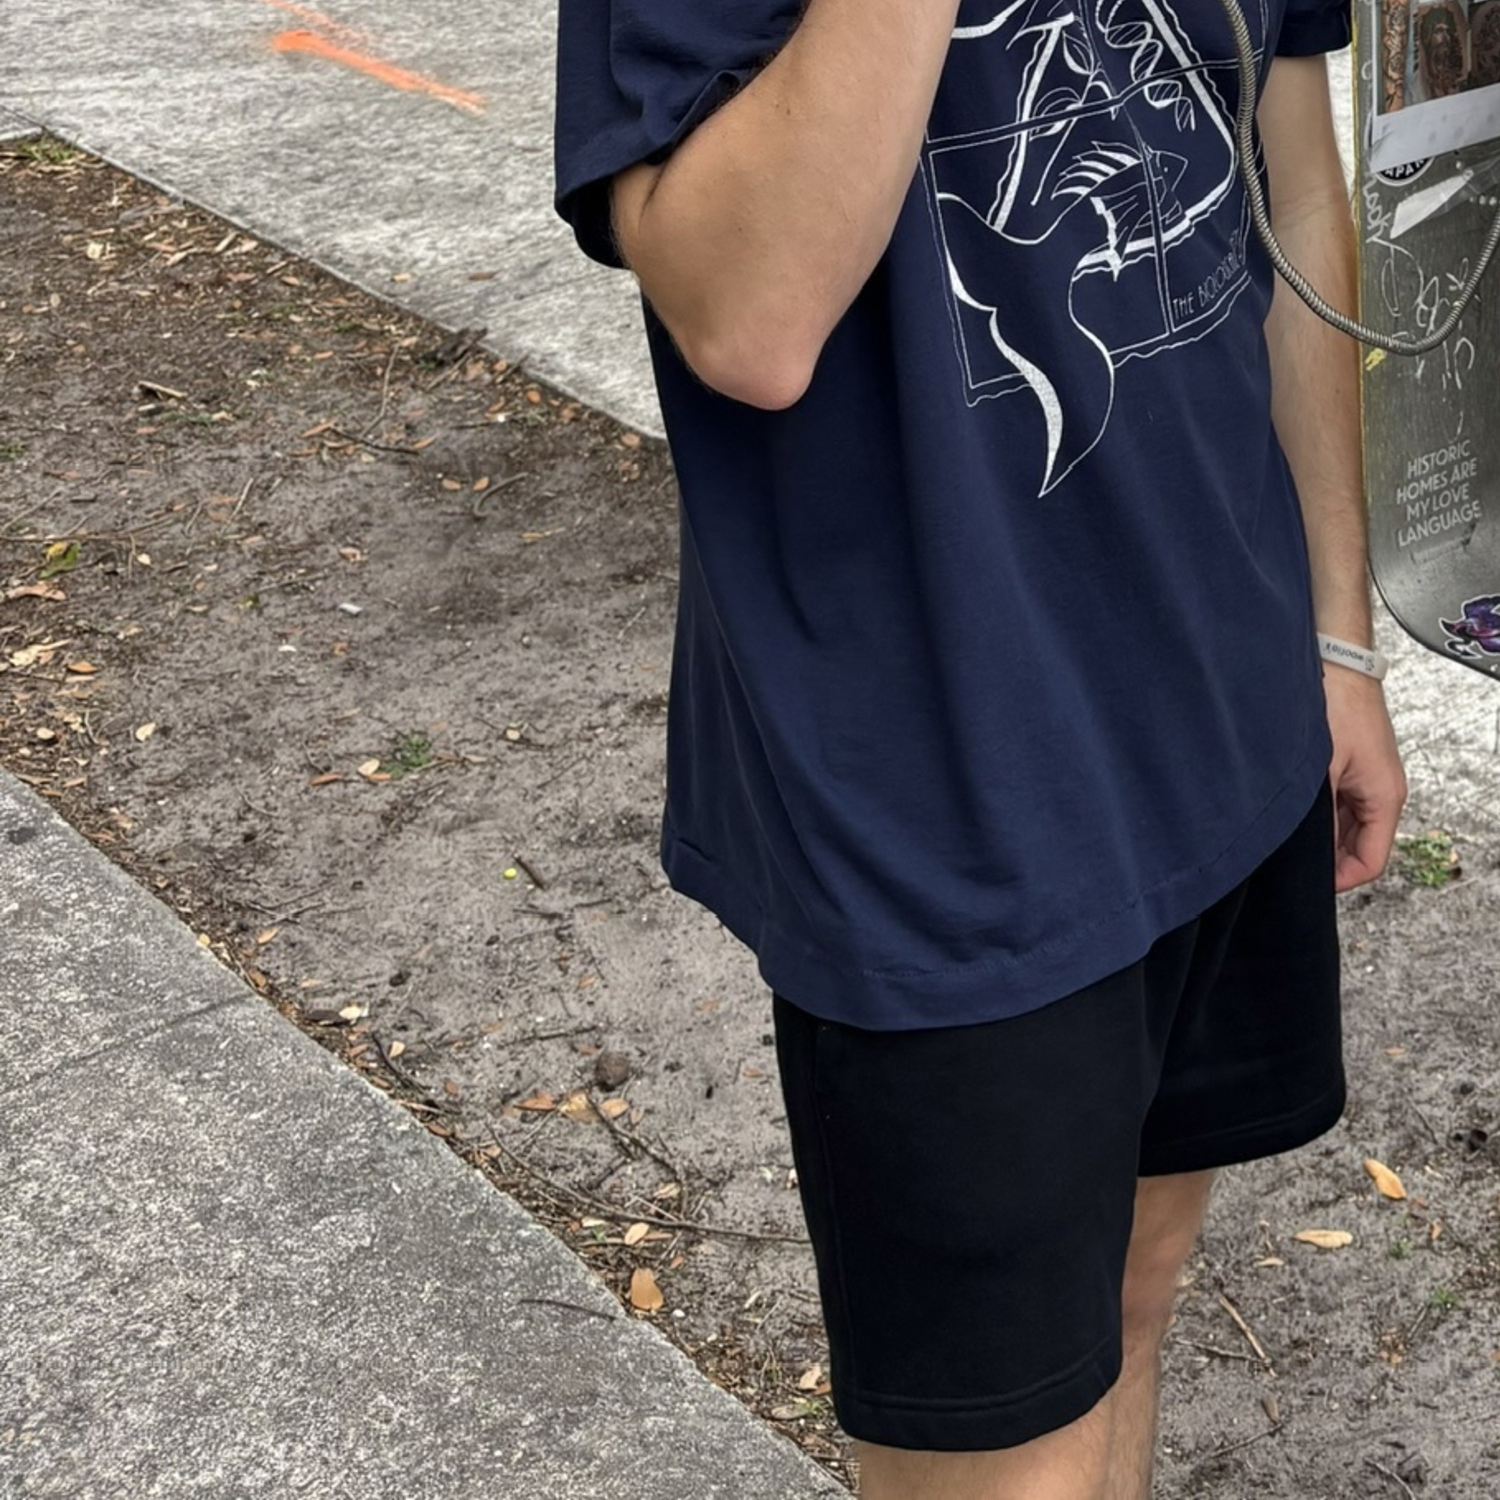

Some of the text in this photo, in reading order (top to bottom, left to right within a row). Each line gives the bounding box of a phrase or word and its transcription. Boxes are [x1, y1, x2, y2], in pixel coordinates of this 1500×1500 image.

[1396, 457, 1477, 505] HOMES ARE
[1408, 439, 1471, 480] HISTORIC
[1397, 499, 1482, 547] LANGUAGE
[1407, 482, 1470, 521] MY LOVE
